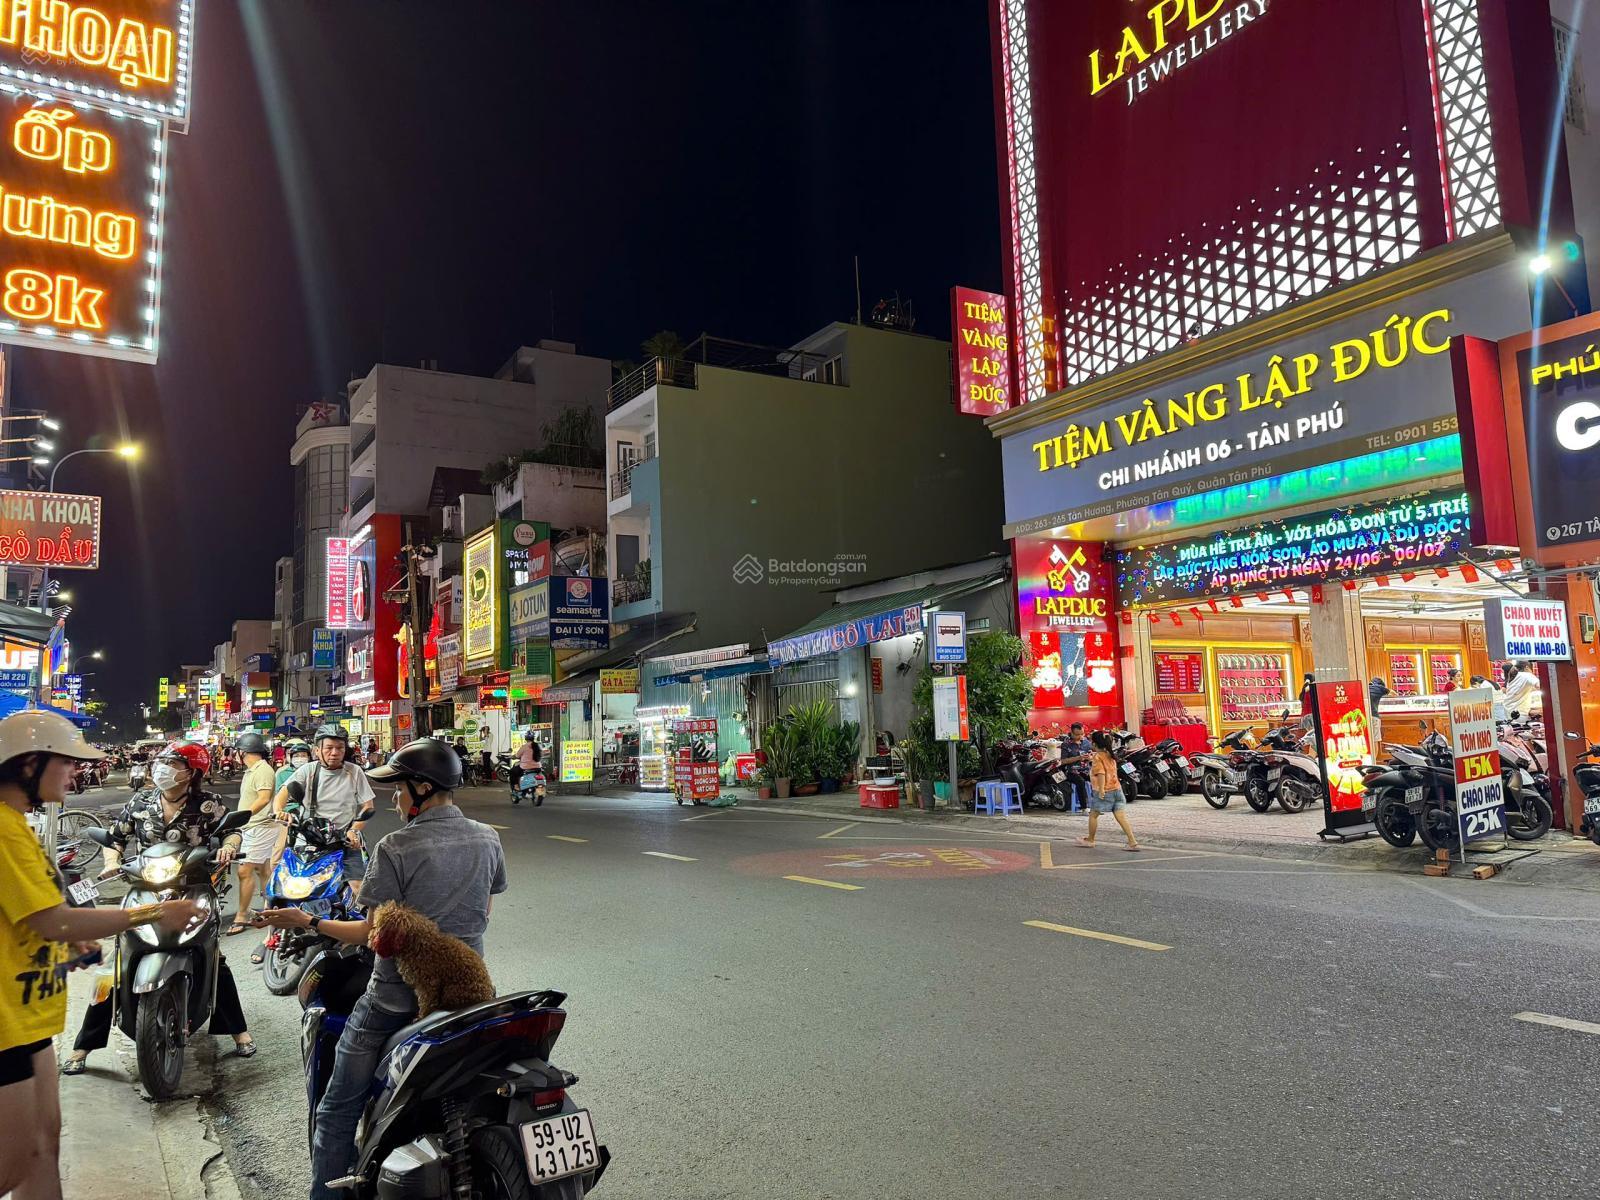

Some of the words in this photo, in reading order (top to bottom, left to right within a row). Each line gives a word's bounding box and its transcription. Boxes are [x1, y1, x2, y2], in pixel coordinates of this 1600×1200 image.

[1126, 0, 1270, 105] JEWELLERY
[0, 186, 136, 259] ưng
[964, 302, 1003, 323] TIỆM
[961, 328, 1008, 351] VÀNG
[971, 356, 1000, 378] LẬP
[970, 383, 1005, 404] ĐỨC
[1033, 420, 1112, 472] TIỆM
[1115, 383, 1227, 447] VÀNG
[1236, 354, 1319, 411] LẬP
[1330, 309, 1451, 383] ĐỨC
[1099, 469, 1130, 490] CHI
[1134, 447, 1201, 481] NHÁNH
[1206, 439, 1231, 461] 06
[1247, 422, 1290, 451] TÂN
[1297, 400, 1344, 438] PHÚ
[1366, 433, 1391, 449] TEL:
[1394, 424, 1427, 442] 0901
[1432, 416, 1459, 433] 553
[41, 499, 92, 525] KHOA
[1015, 520, 1033, 534] ADD:
[1034, 513, 1066, 530] 263-265
[1151, 488, 1169, 501] Tân
[1197, 475, 1226, 491] Quận
[1229, 467, 1248, 482] Tân
[1251, 463, 1272, 479] Phú
[1180, 544, 1208, 561] MÙA
[1210, 539, 1227, 556] HÈ
[1228, 536, 1251, 552] TRI
[1254, 531, 1273, 549] ÂN
[1285, 524, 1311, 544] VỚI
[1316, 518, 1347, 538] HÓA
[1350, 512, 1386, 531] ĐƠN
[1389, 504, 1412, 525] TỪ
[1241, 550, 1269, 567] NÓN
[1310, 537, 1330, 556] ÁO
[1333, 533, 1368, 553] MƯA
[1370, 527, 1392, 545] VÀ
[1395, 521, 1419, 541] DÙ
[1423, 518, 1462, 539] ĐỘC
[1562, 521, 1582, 537] 267
[37, 527, 93, 563] DẦU
[1210, 570, 1228, 588] ÁP
[1269, 560, 1289, 579] TỪ
[1291, 555, 1331, 577] NGÀY
[1335, 550, 1380, 571] 24/06
[1395, 541, 1444, 561] 06/07
[519, 592, 546, 619] JOTUN
[556, 607, 603, 615] seamaster
[904, 608, 920, 622] 261
[1035, 596, 1106, 617] LAPDUC
[1504, 605, 1531, 621] CHÁO
[1534, 603, 1563, 622] HUYẾT
[573, 625, 583, 634] LÝ
[585, 625, 604, 635] SƠN
[831, 623, 859, 651] CÔ
[865, 616, 903, 642] LAI
[1048, 615, 1096, 626] JEWELLERY
[1507, 639, 1532, 656] CHÁO
[1453, 701, 1471, 724] CHÁO
[1472, 694, 1493, 720] HUYẾT
[1462, 756, 1493, 780] 15K
[1461, 782, 1484, 810] CHÁO
[1466, 807, 1503, 837] 25K
[532, 1116, 584, 1149] 59-U2
[535, 1140, 595, 1178] 431.25
